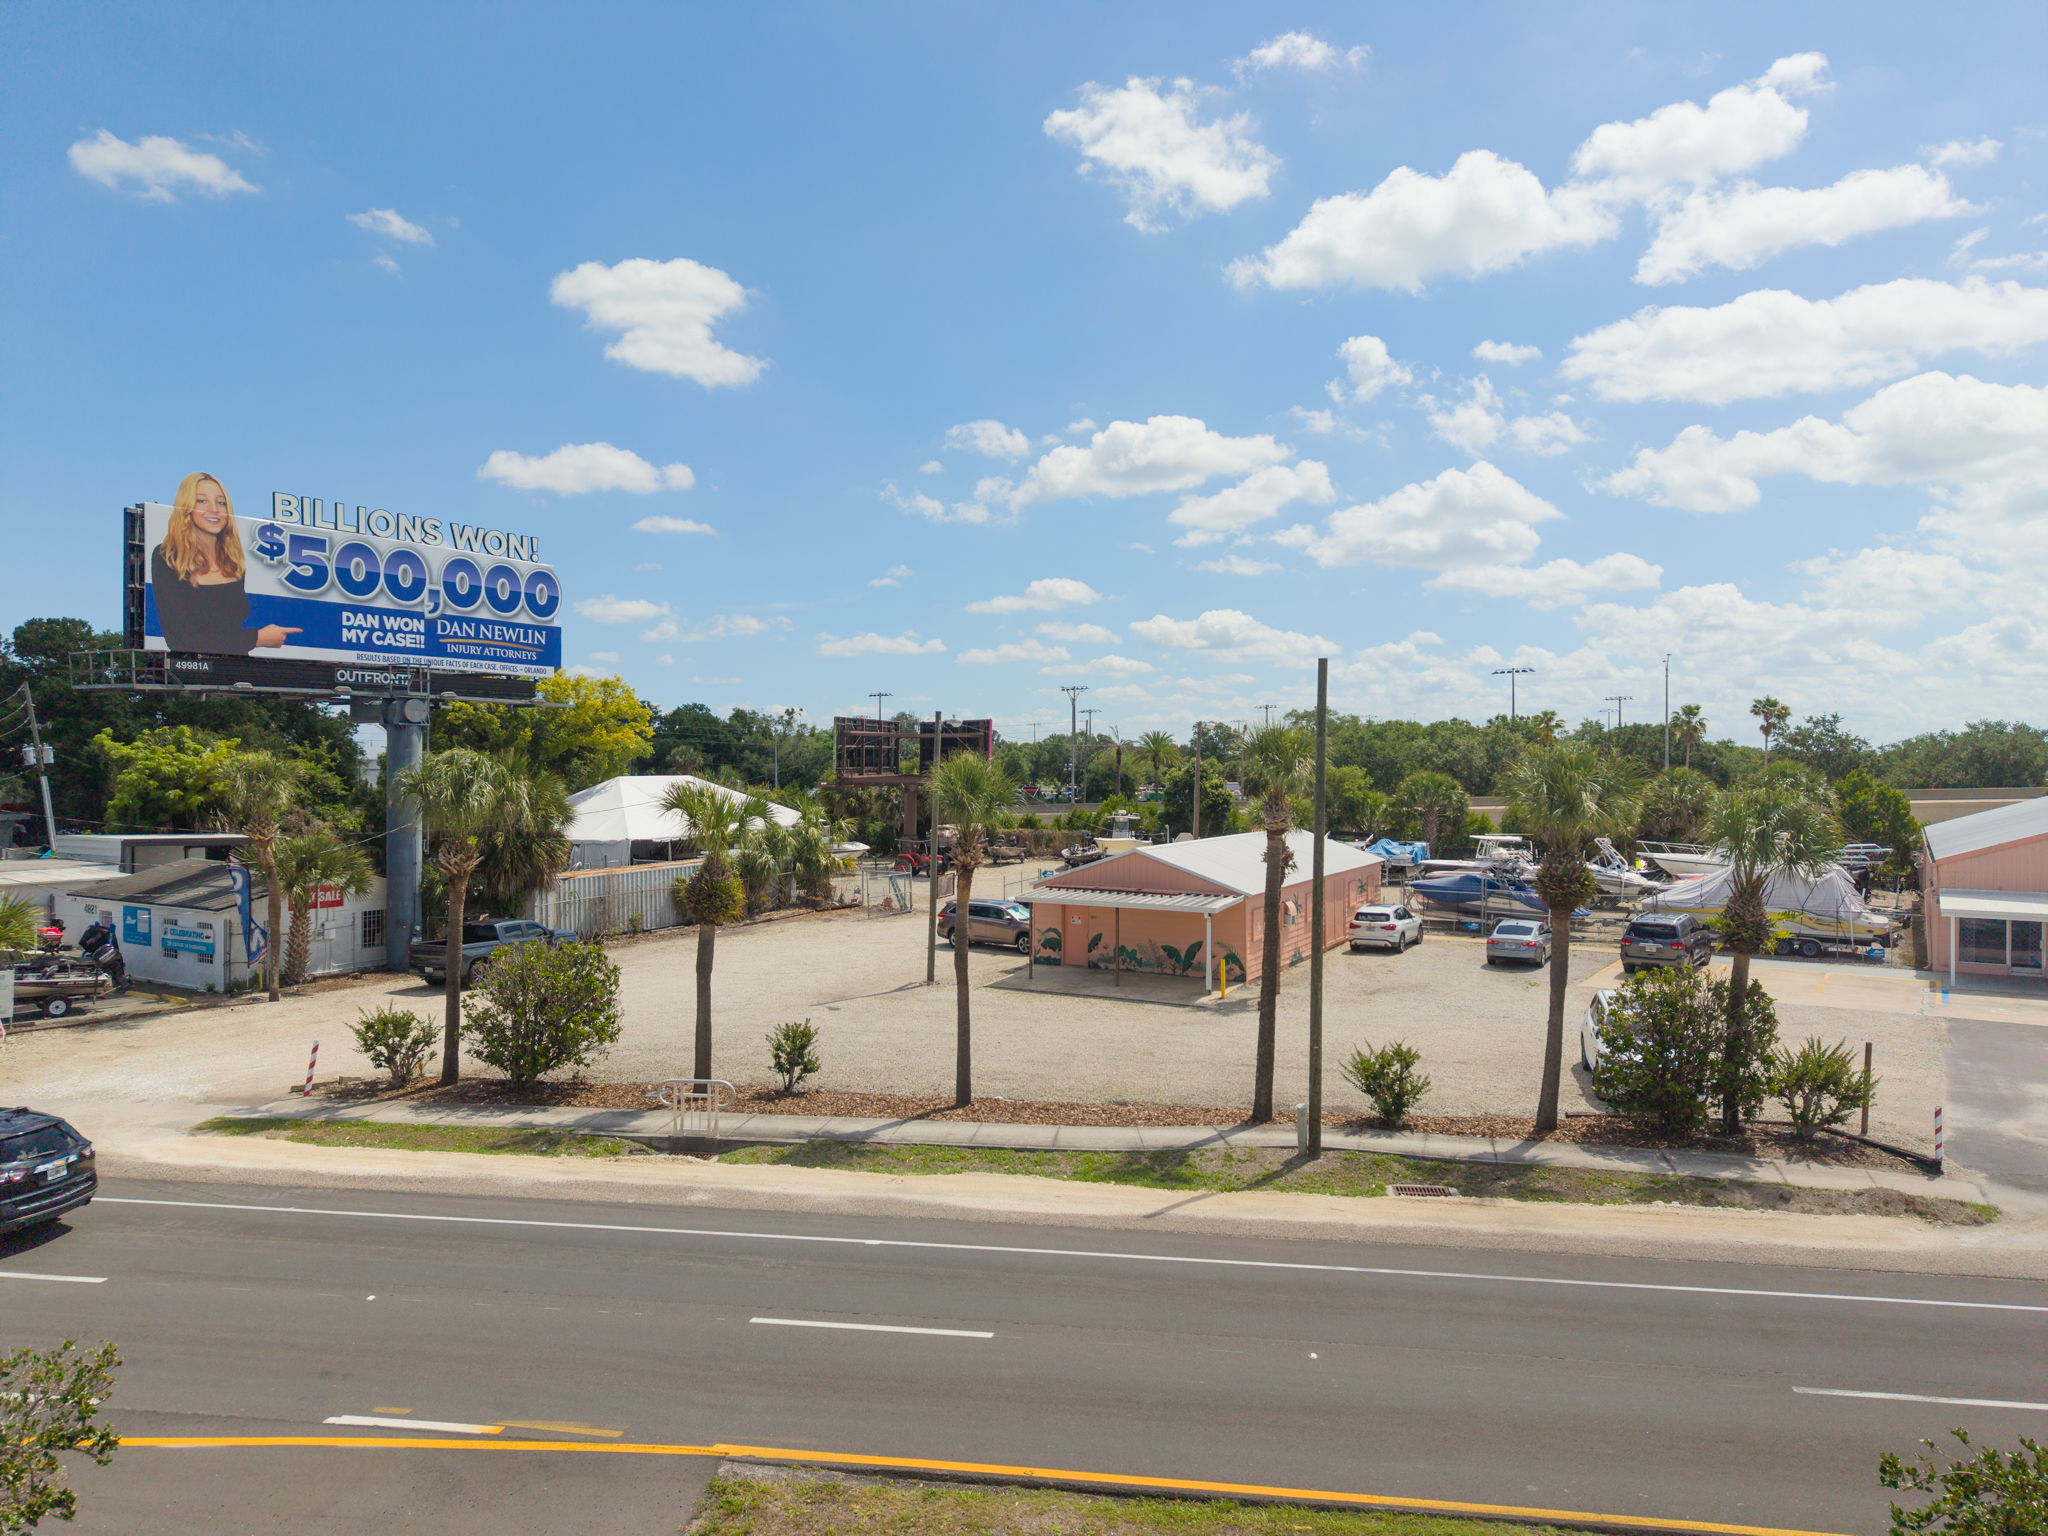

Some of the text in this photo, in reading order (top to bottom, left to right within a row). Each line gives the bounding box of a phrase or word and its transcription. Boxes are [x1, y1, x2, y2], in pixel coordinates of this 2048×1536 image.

[272, 491, 539, 562] BILLIONS WON!
[253, 522, 561, 620] $500,000
[342, 611, 425, 632] DAN WON
[436, 619, 546, 645] DAN NEWLIN
[342, 628, 425, 648] MY CASE!!
[447, 643, 537, 660] INJURY ATTORNEYS
[175, 660, 209, 671] 49981A
[356, 653, 381, 663] RESULTS
[382, 655, 400, 663] BASED
[424, 658, 445, 667] UNIQUE
[446, 659, 461, 668] FACTS
[470, 661, 484, 669] EACH
[500, 664, 518, 672] OFFICES
[524, 666, 547, 675] ORLANDO
